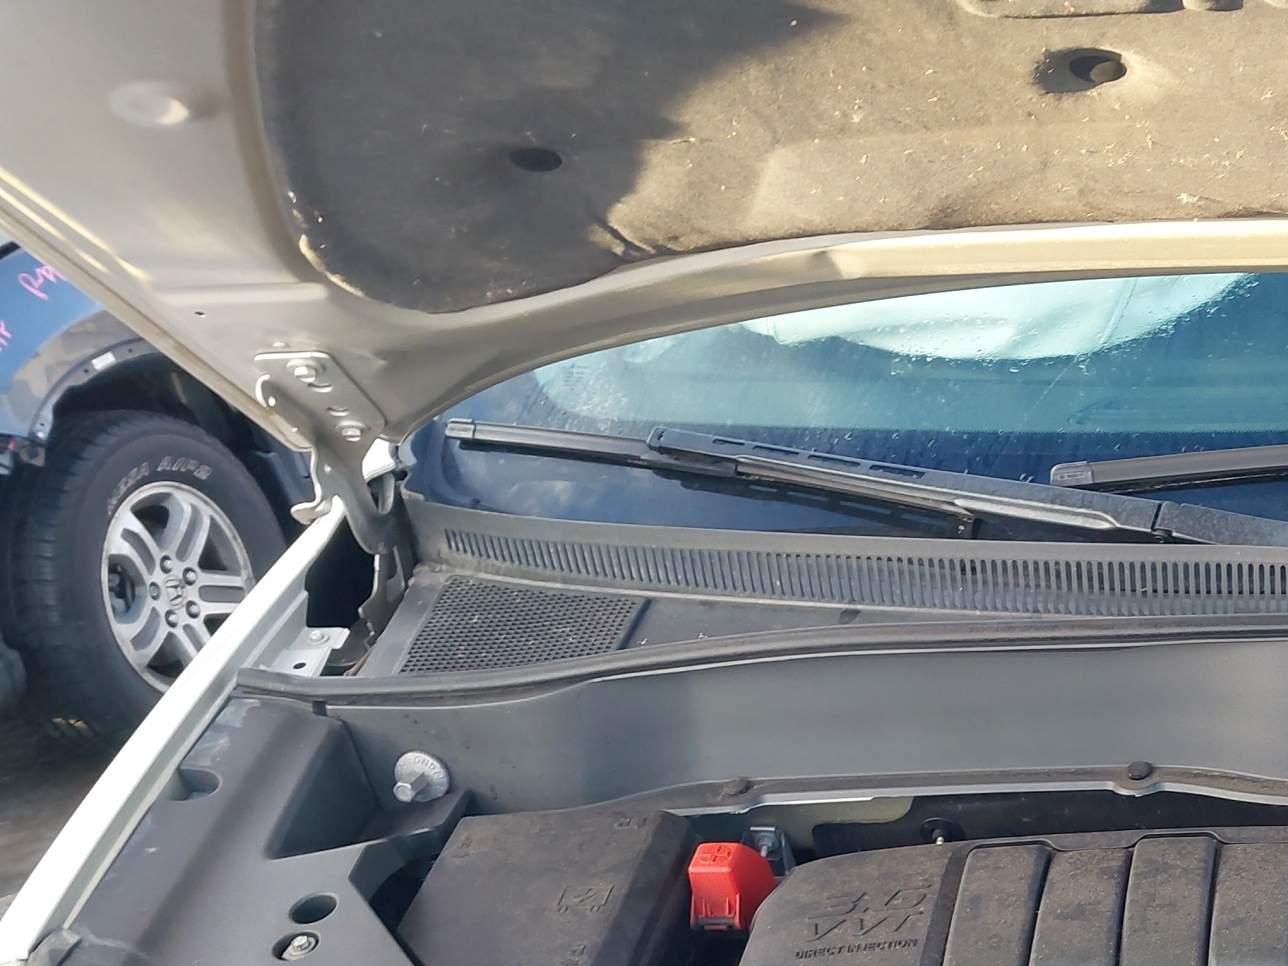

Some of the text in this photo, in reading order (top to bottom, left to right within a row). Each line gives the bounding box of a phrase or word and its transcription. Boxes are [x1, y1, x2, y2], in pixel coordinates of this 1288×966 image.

[805, 911, 924, 943] VVT
[795, 938, 919, 959] DIRECT INJECTION
